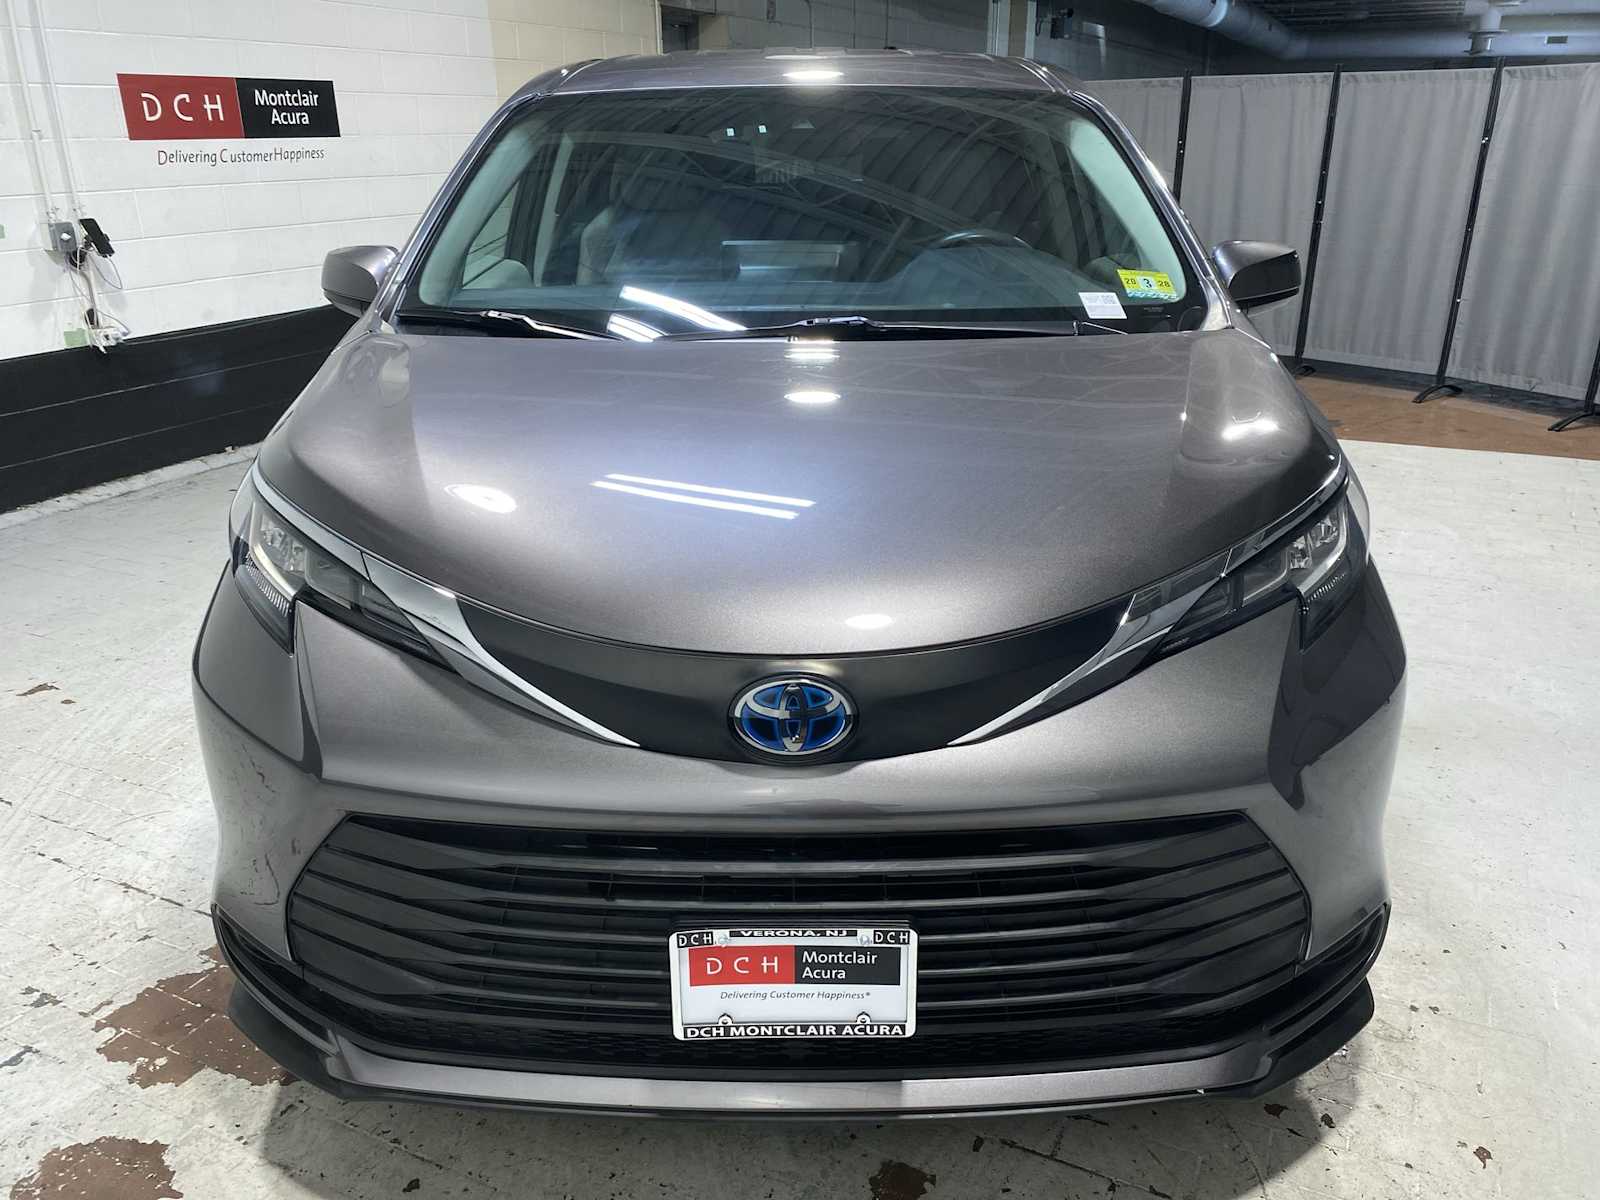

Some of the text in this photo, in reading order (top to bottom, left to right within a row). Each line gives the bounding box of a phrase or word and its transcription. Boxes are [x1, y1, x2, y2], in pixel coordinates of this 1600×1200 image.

[254, 89, 319, 107] Montclair
[140, 92, 224, 122] DCH
[271, 109, 310, 125] Acura
[157, 149, 217, 167] Delivering
[274, 147, 325, 162] Happiness
[1143, 278, 1152, 288] 3
[678, 933, 713, 947] DCH
[875, 932, 909, 944] DCH
[802, 951, 878, 964] Montclair
[705, 956, 778, 975] DCH
[802, 967, 846, 979] Acura
[720, 991, 767, 1001] Delivering
[770, 991, 815, 999] Customer
[686, 1024, 903, 1038] DCH MONTCLAIR ACURA
